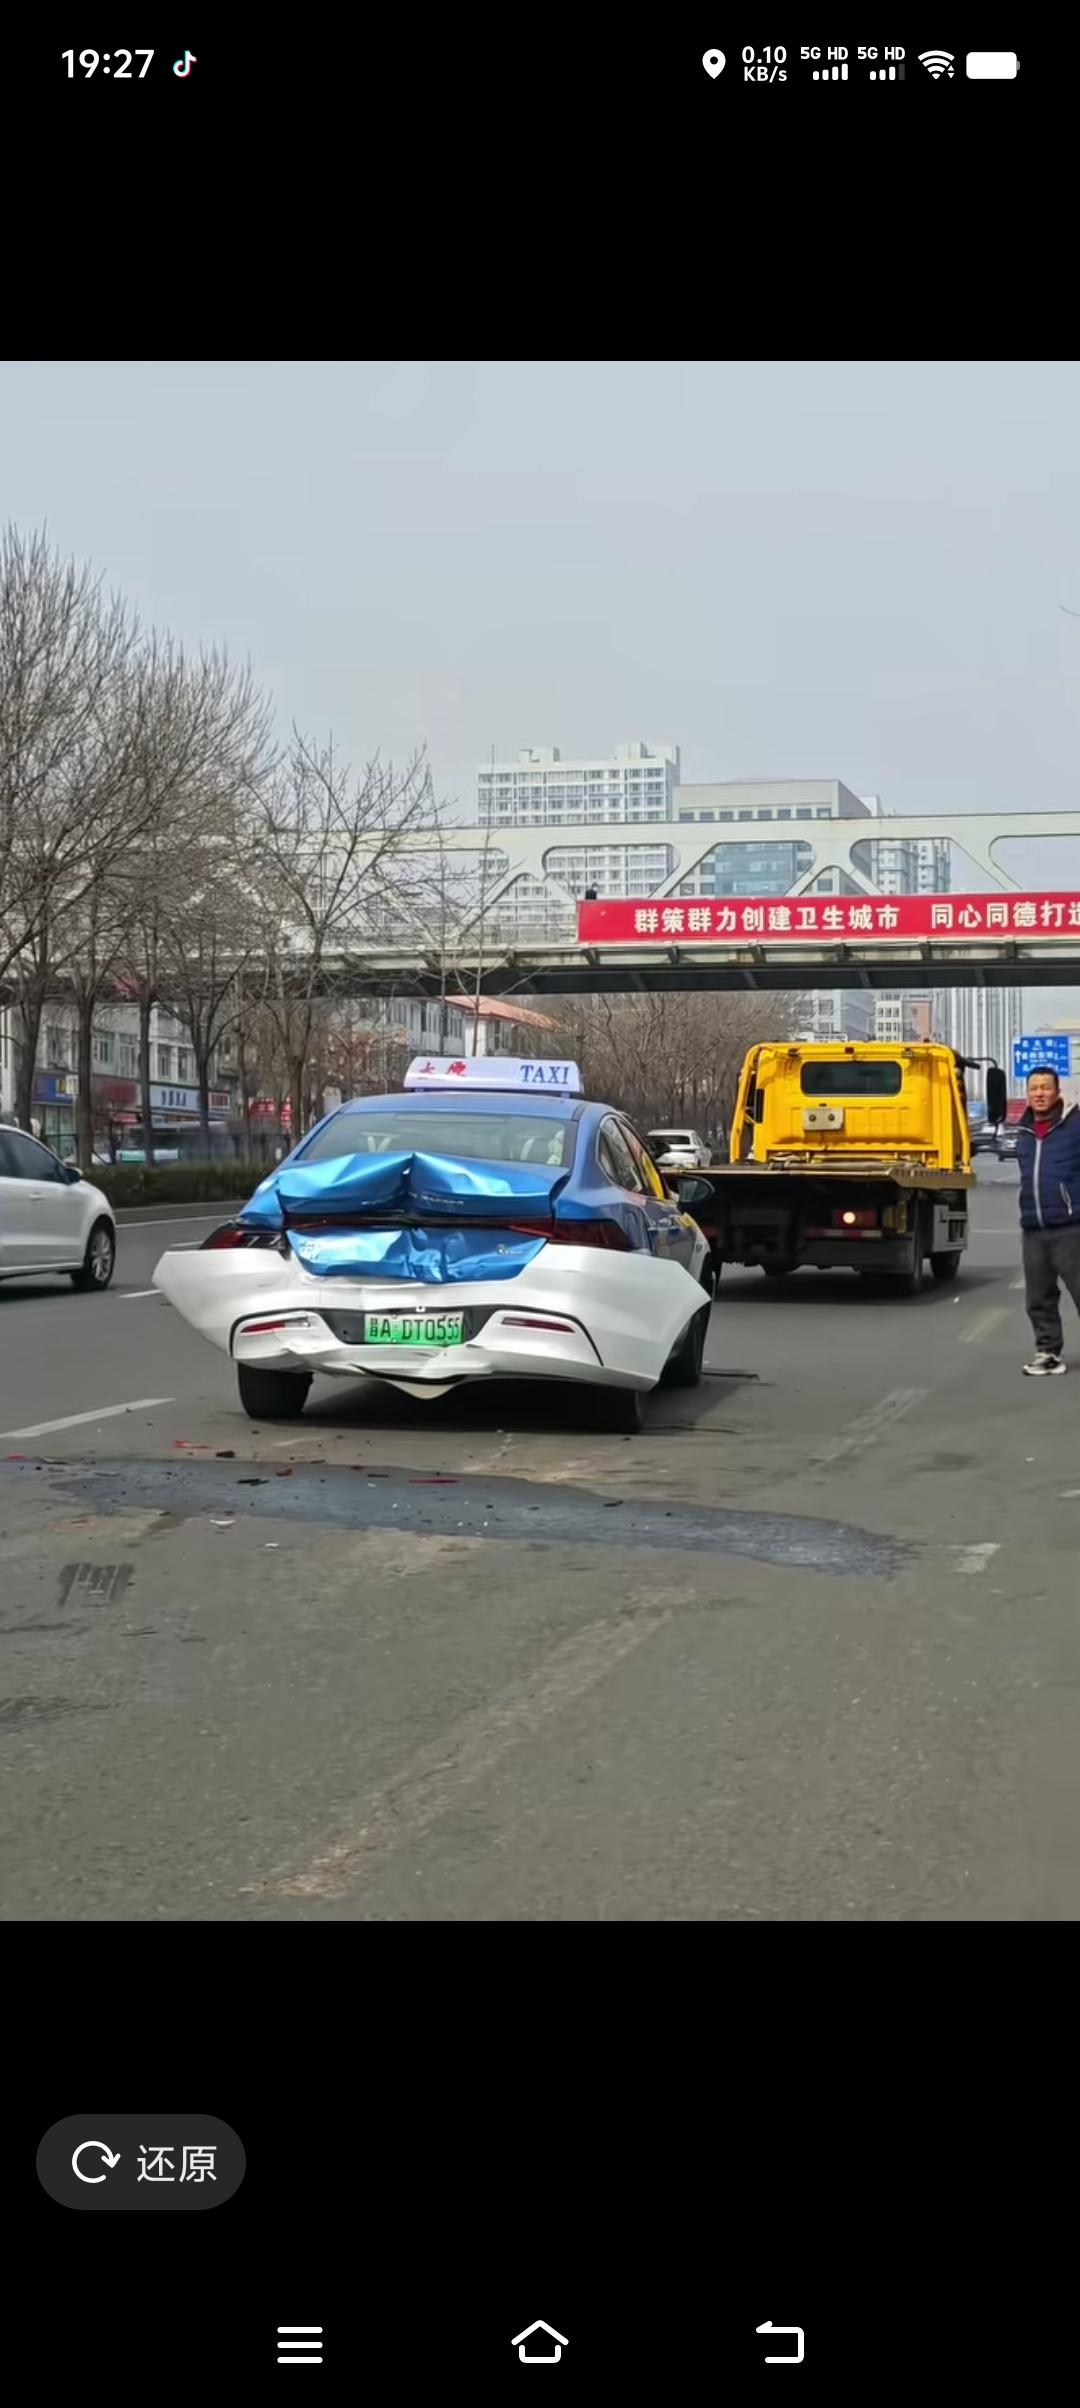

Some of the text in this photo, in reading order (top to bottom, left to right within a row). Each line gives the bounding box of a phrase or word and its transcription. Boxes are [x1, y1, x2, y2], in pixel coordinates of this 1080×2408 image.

[634, 904, 900, 933] 群策群力创建卫生城市
[520, 1064, 570, 1085] TAXI
